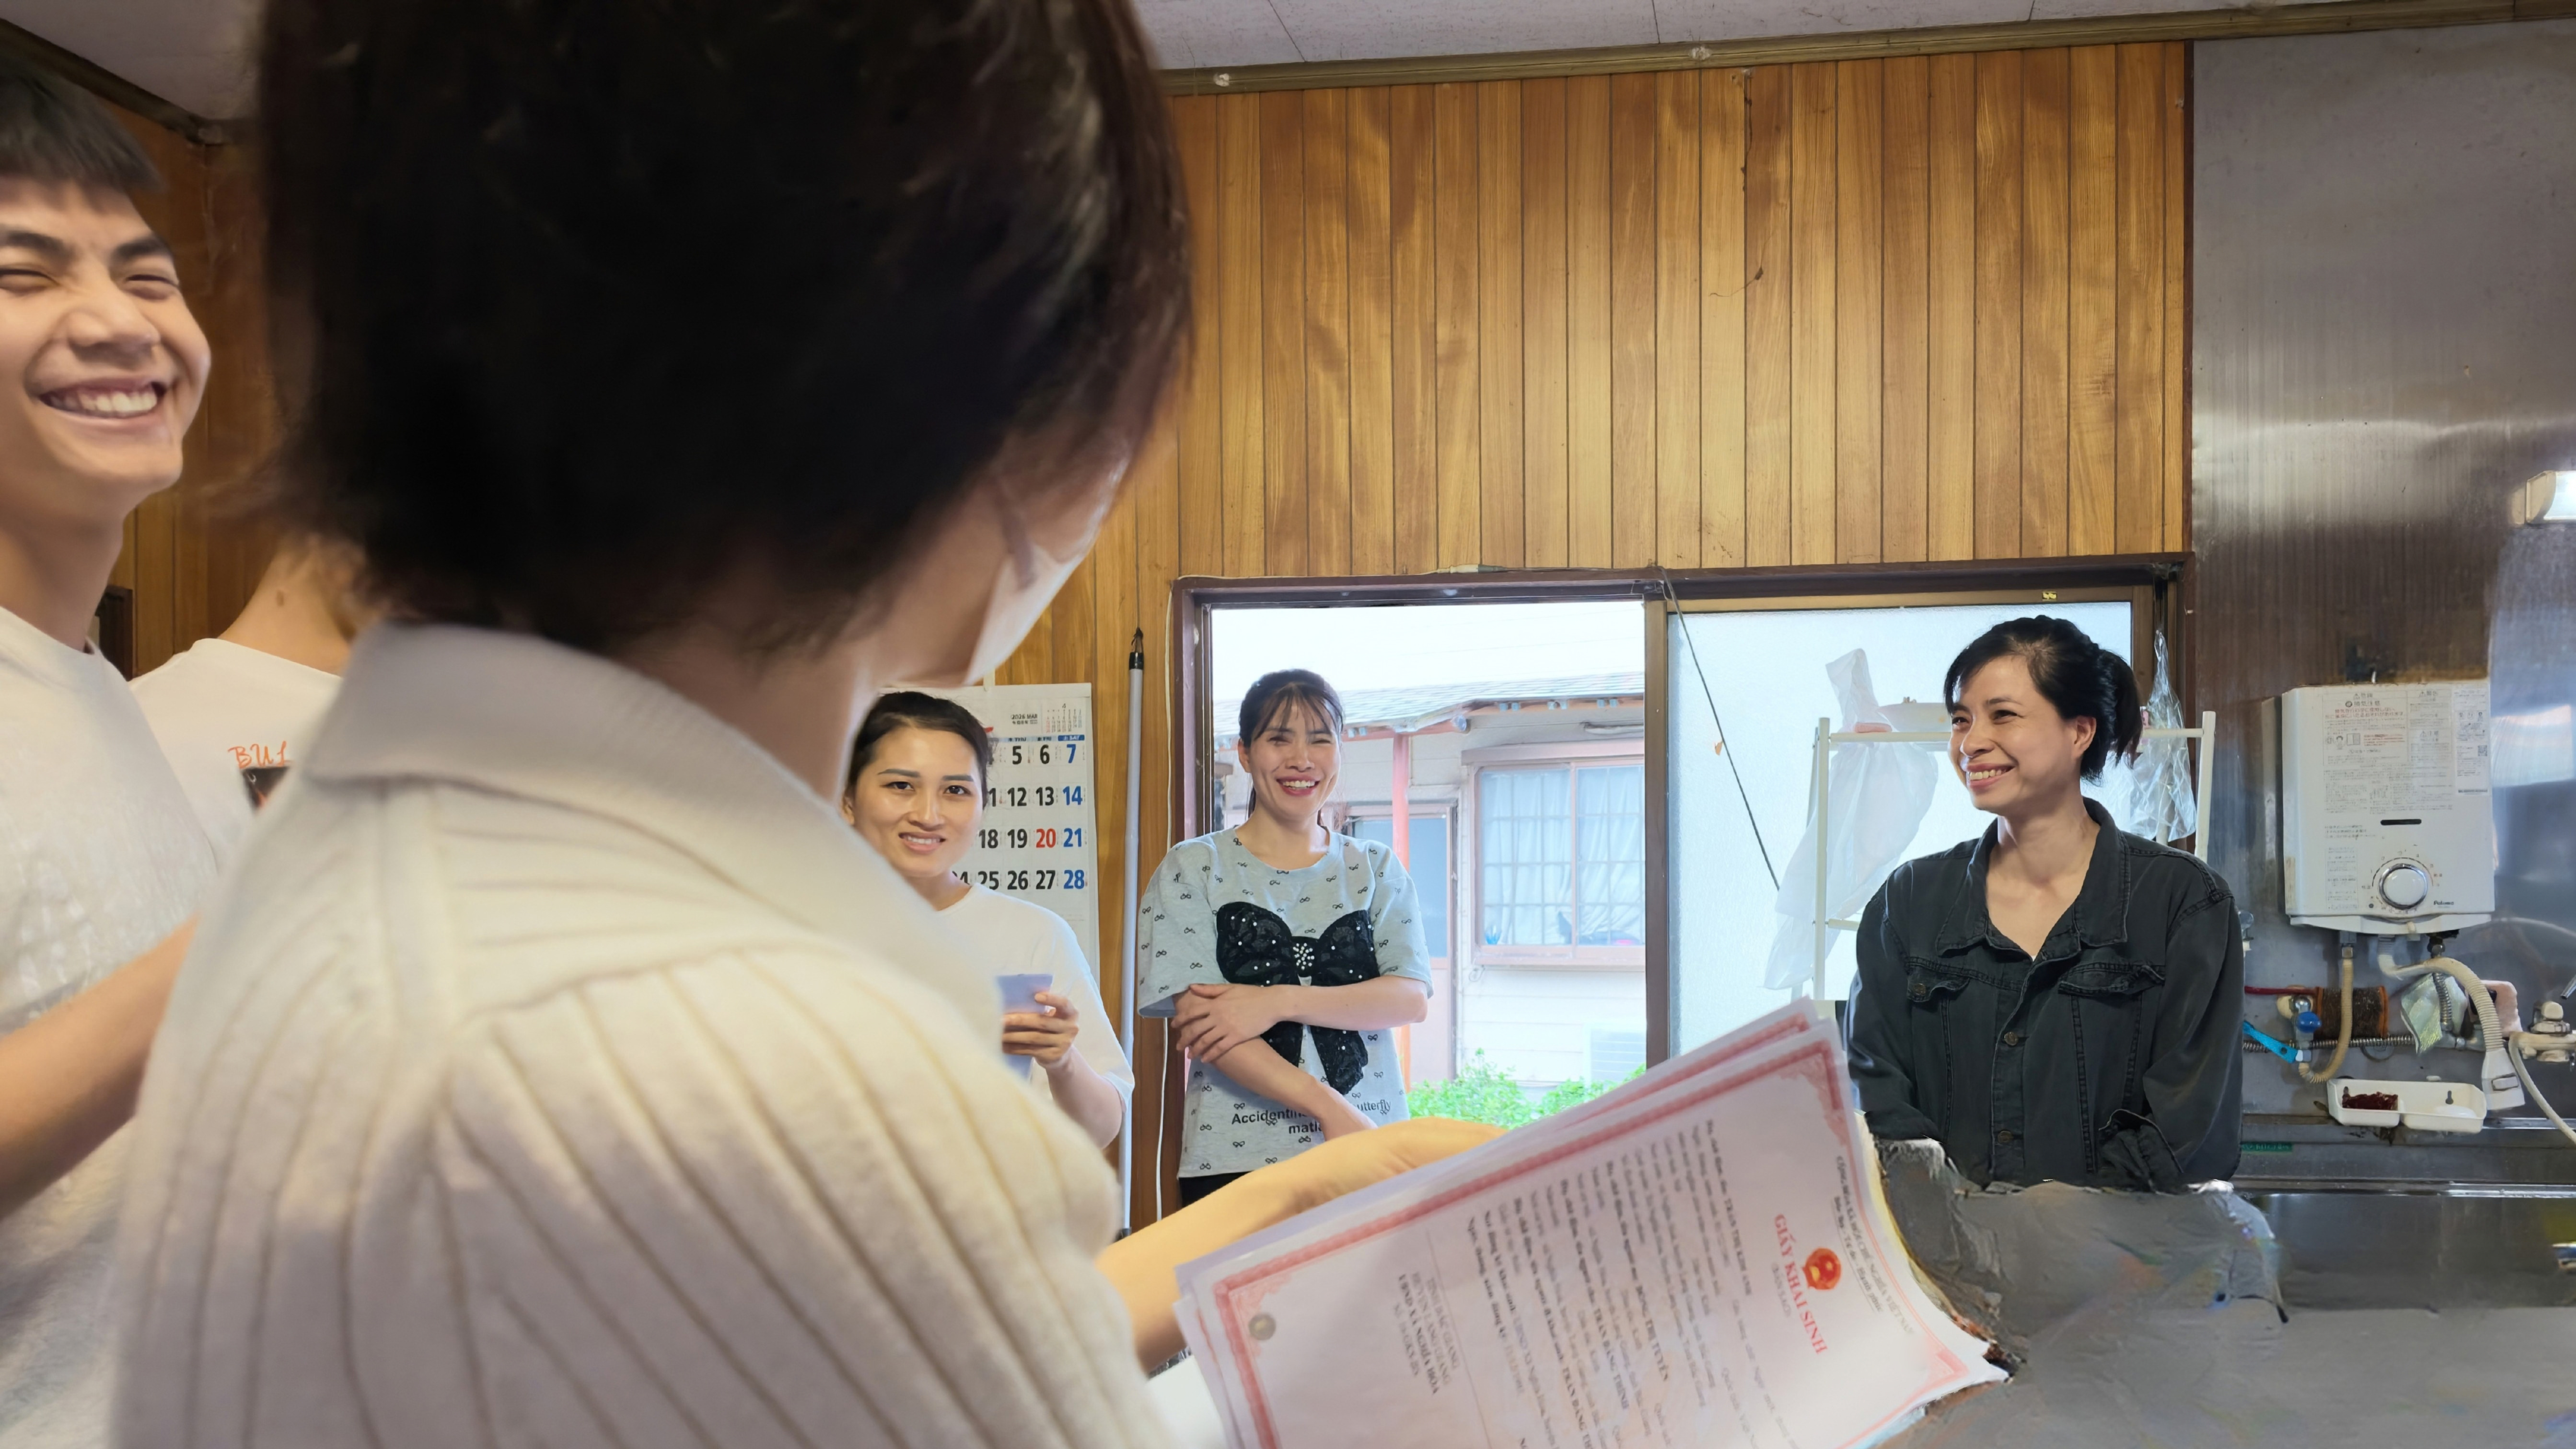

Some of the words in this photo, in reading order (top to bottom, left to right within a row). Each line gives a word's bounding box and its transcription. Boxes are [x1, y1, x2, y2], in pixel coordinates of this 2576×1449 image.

[1012, 745, 1022, 765] 5
[1040, 744, 1050, 764] 6
[1067, 744, 1076, 764] 7
[989, 787, 996, 807] 1
[1007, 787, 1027, 806] 12
[1036, 786, 1055, 806] 13
[1063, 786, 1083, 806] 14
[978, 829, 999, 849] 18
[1007, 829, 1028, 849] 19
[1036, 828, 1057, 848] 20
[1063, 828, 1082, 847] 21
[978, 871, 999, 890] 25
[1007, 870, 1028, 890] 26
[1036, 870, 1056, 889] 27
[1063, 869, 1085, 889] 28
[1357, 1099, 1391, 1112] utterfly
[1775, 1214, 1795, 1256] GIẤY
[1784, 1262, 1807, 1308] KHAI
[1804, 1311, 1827, 1353] SINH
